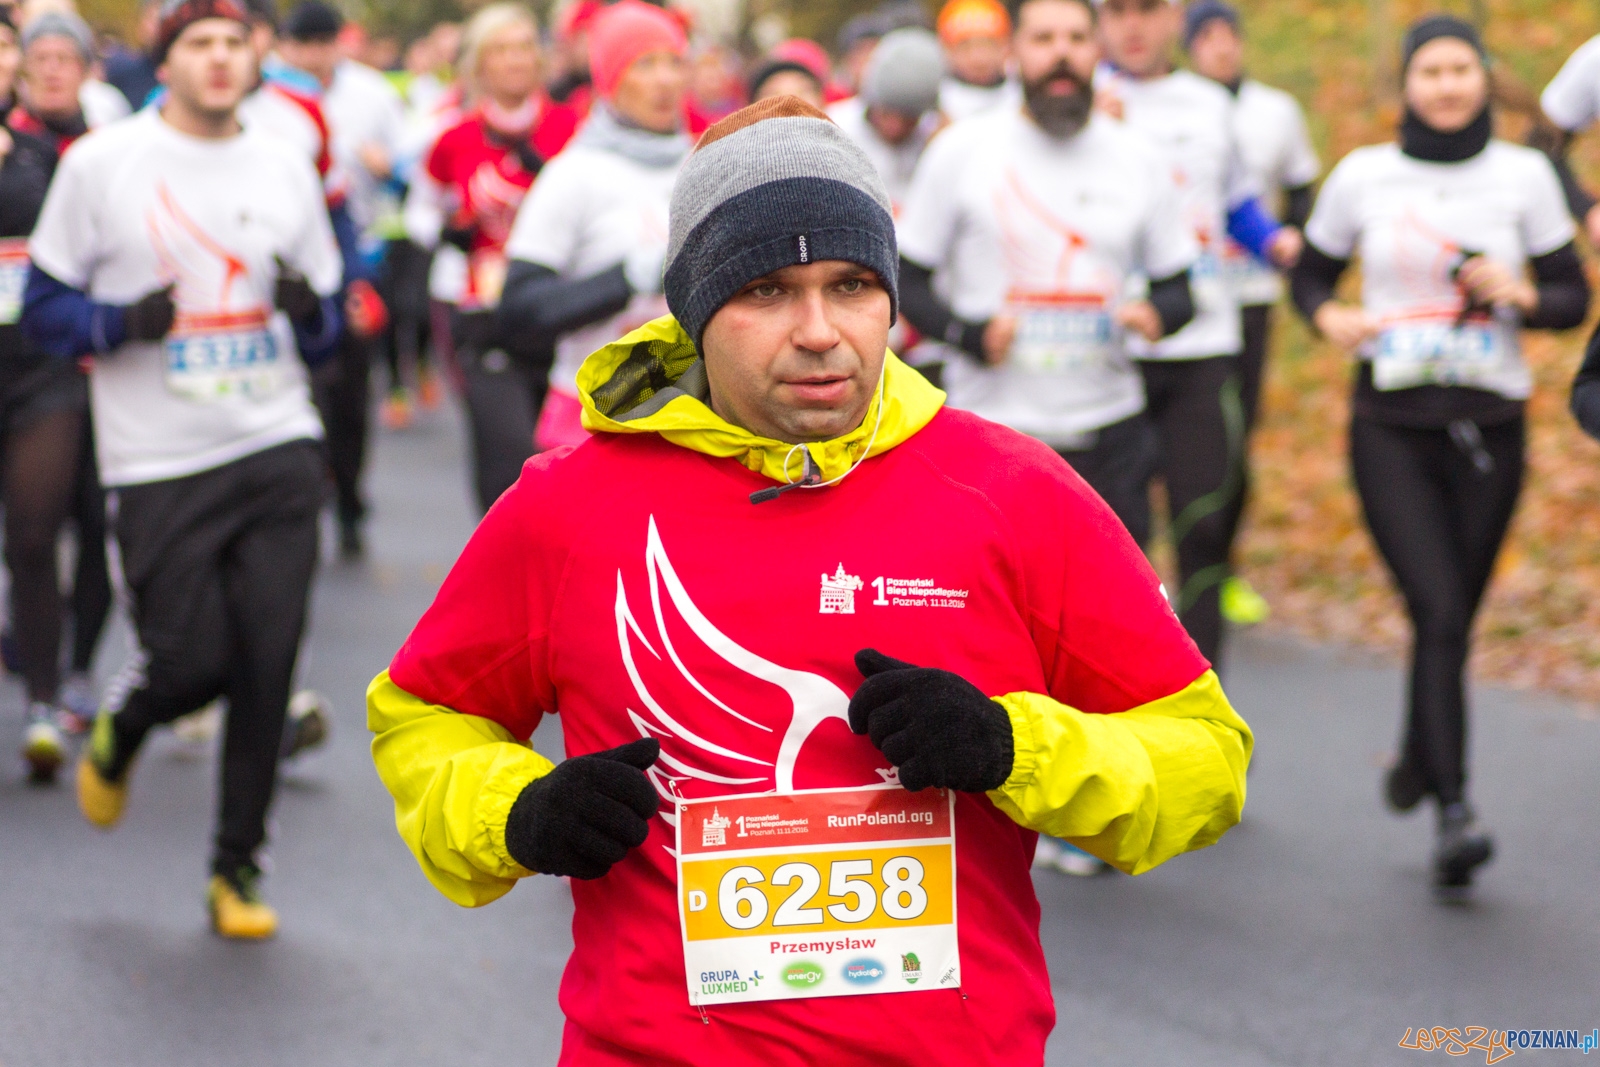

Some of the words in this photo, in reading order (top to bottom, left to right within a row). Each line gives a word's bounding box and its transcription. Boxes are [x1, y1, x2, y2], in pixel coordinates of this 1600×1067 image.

[799, 235, 807, 262] CROPP
[886, 577, 934, 587] Poznański
[871, 576, 889, 606] 1
[886, 586, 907, 596] Bieg
[908, 587, 969, 598] Niepodległości
[892, 597, 929, 607] Poznań,
[930, 598, 966, 609] 11.11.2016
[746, 814, 779, 822] Poznański
[827, 810, 933, 828] RunPoland.org
[735, 816, 748, 837] 1
[688, 890, 708, 912] D
[718, 856, 928, 929] 6258
[770, 937, 876, 955] Przemysław
[700, 969, 740, 983] GRUPA
[787, 971, 821, 983] energy
[701, 981, 748, 995] LUXMED
